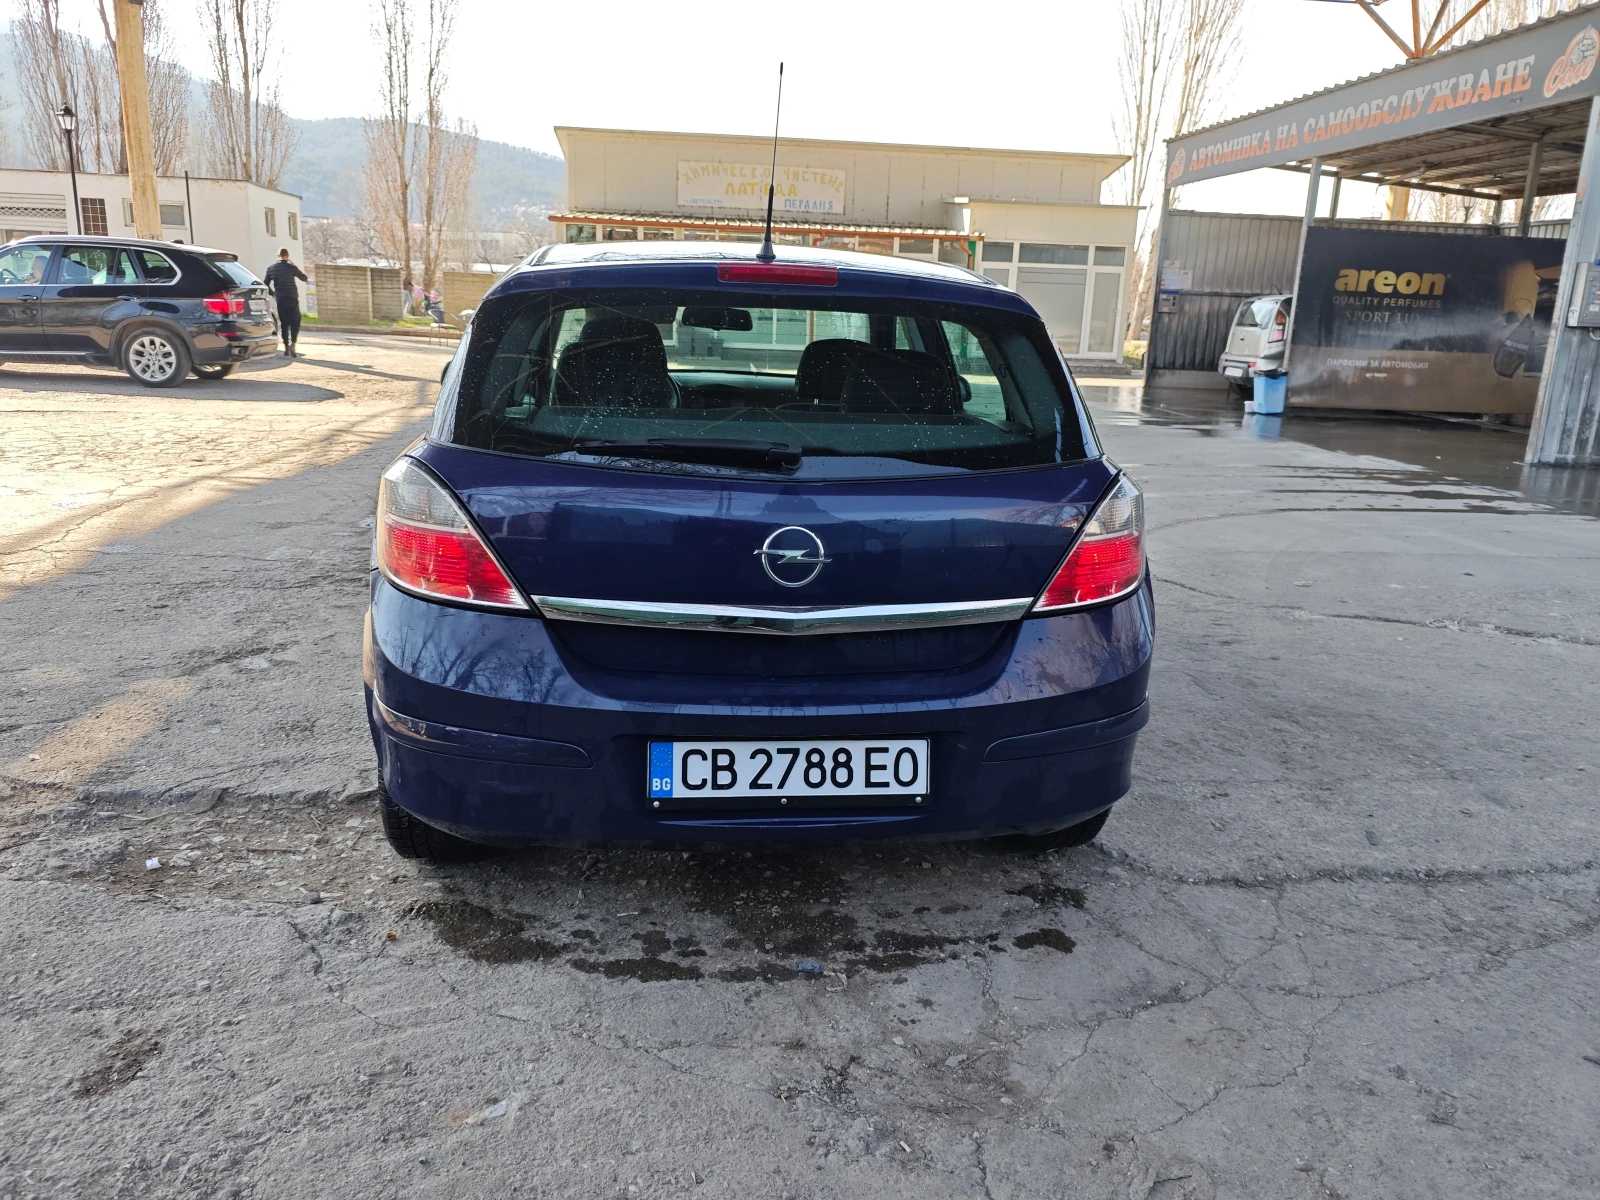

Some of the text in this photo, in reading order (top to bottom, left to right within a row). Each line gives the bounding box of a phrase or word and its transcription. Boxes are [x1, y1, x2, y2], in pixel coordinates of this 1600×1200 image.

[1188, 54, 1534, 172] АВТОМИВКА НА САМООБСЛУЖВАНЕ
[682, 164, 844, 193] ХИМИЧЕСКО ЧИСТЕНЕ
[784, 198, 834, 211] ПЕРАЛНЯ
[1334, 268, 1446, 296] areon
[1332, 295, 1441, 309] QUALITY PERFUMES
[1345, 310, 1424, 324] SPORT LUX
[1326, 358, 1429, 369] ПАРФЮМИ ЗА АВТОМОБИЛ
[681, 749, 738, 790] CB
[748, 748, 854, 789] 2788
[652, 778, 671, 790] BG
